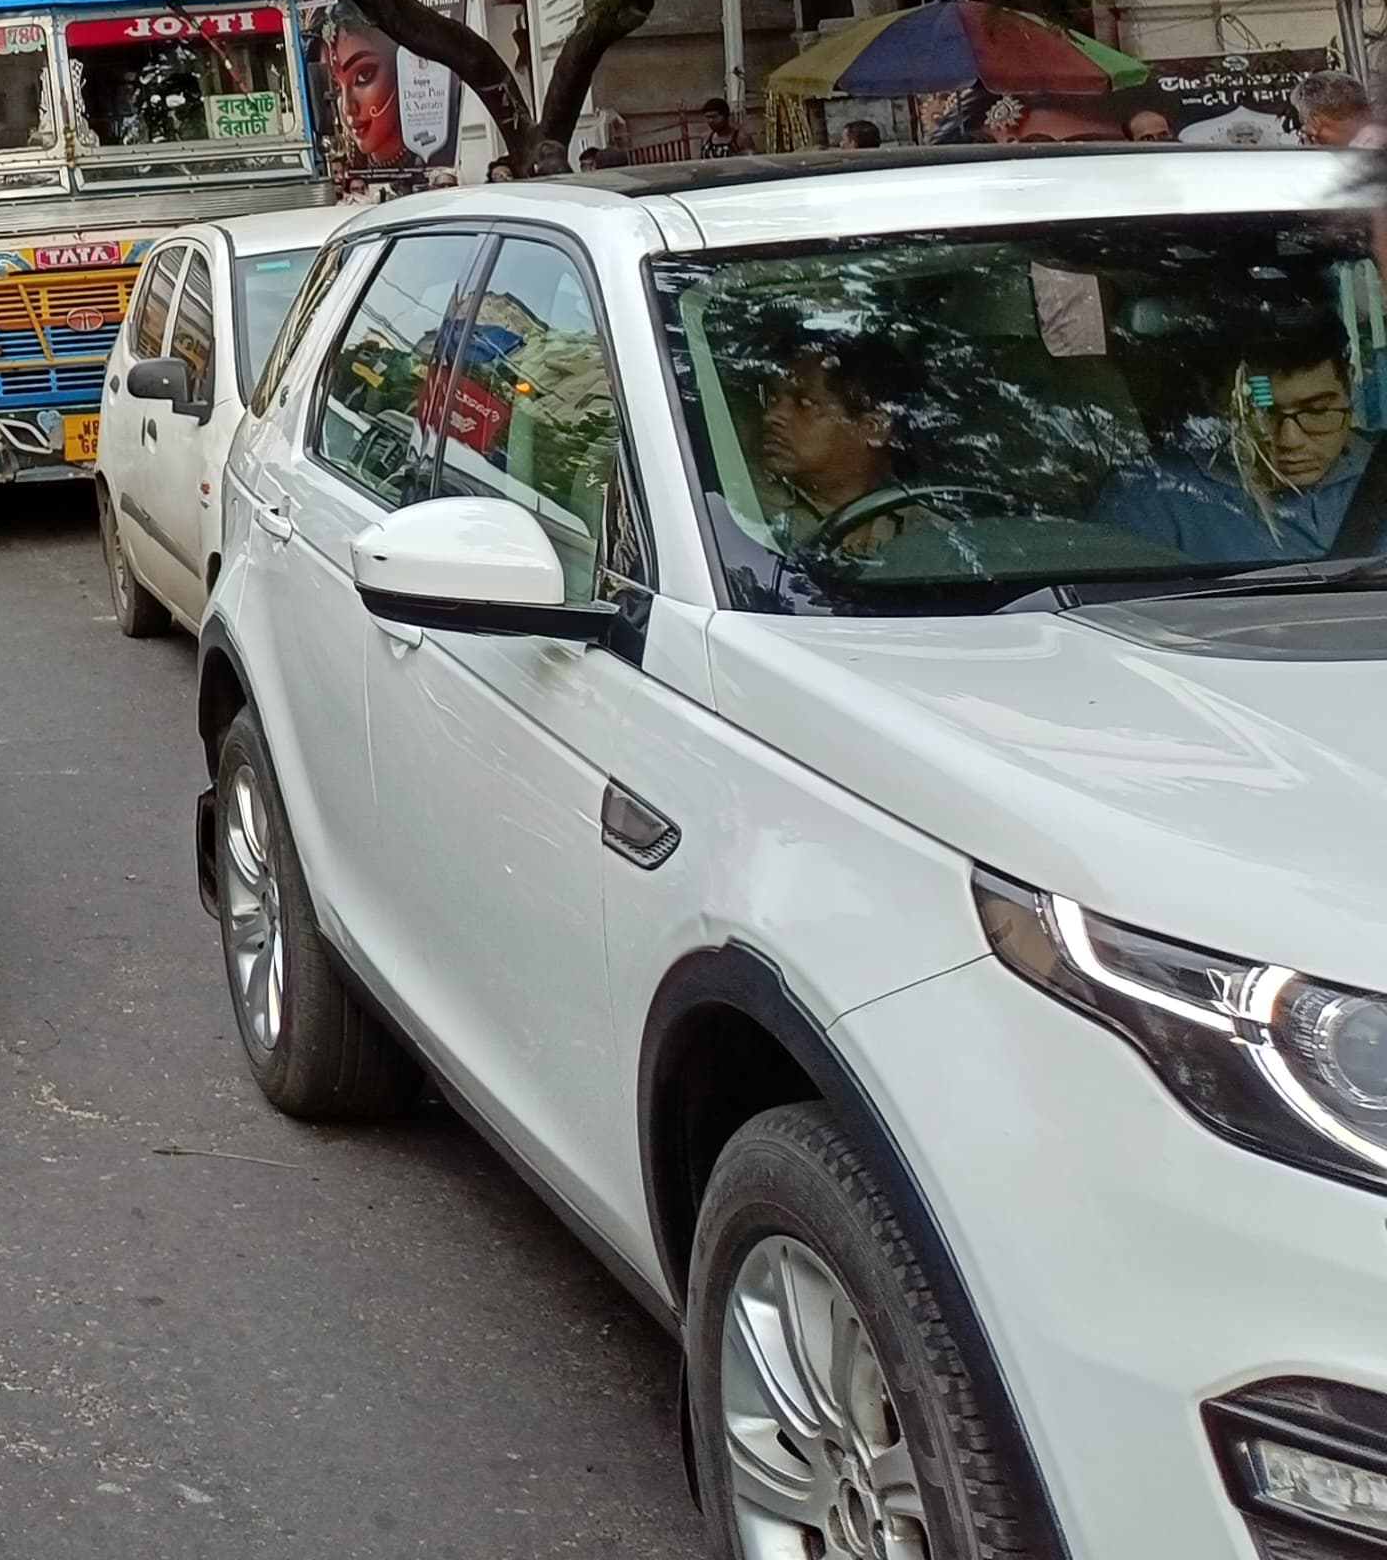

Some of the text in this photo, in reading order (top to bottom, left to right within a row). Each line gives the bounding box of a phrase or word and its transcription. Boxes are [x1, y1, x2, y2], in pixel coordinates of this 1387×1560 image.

[123, 11, 256, 38] JOYTI
[1158, 75, 1201, 92] The
[45, 246, 110, 265] TATA
